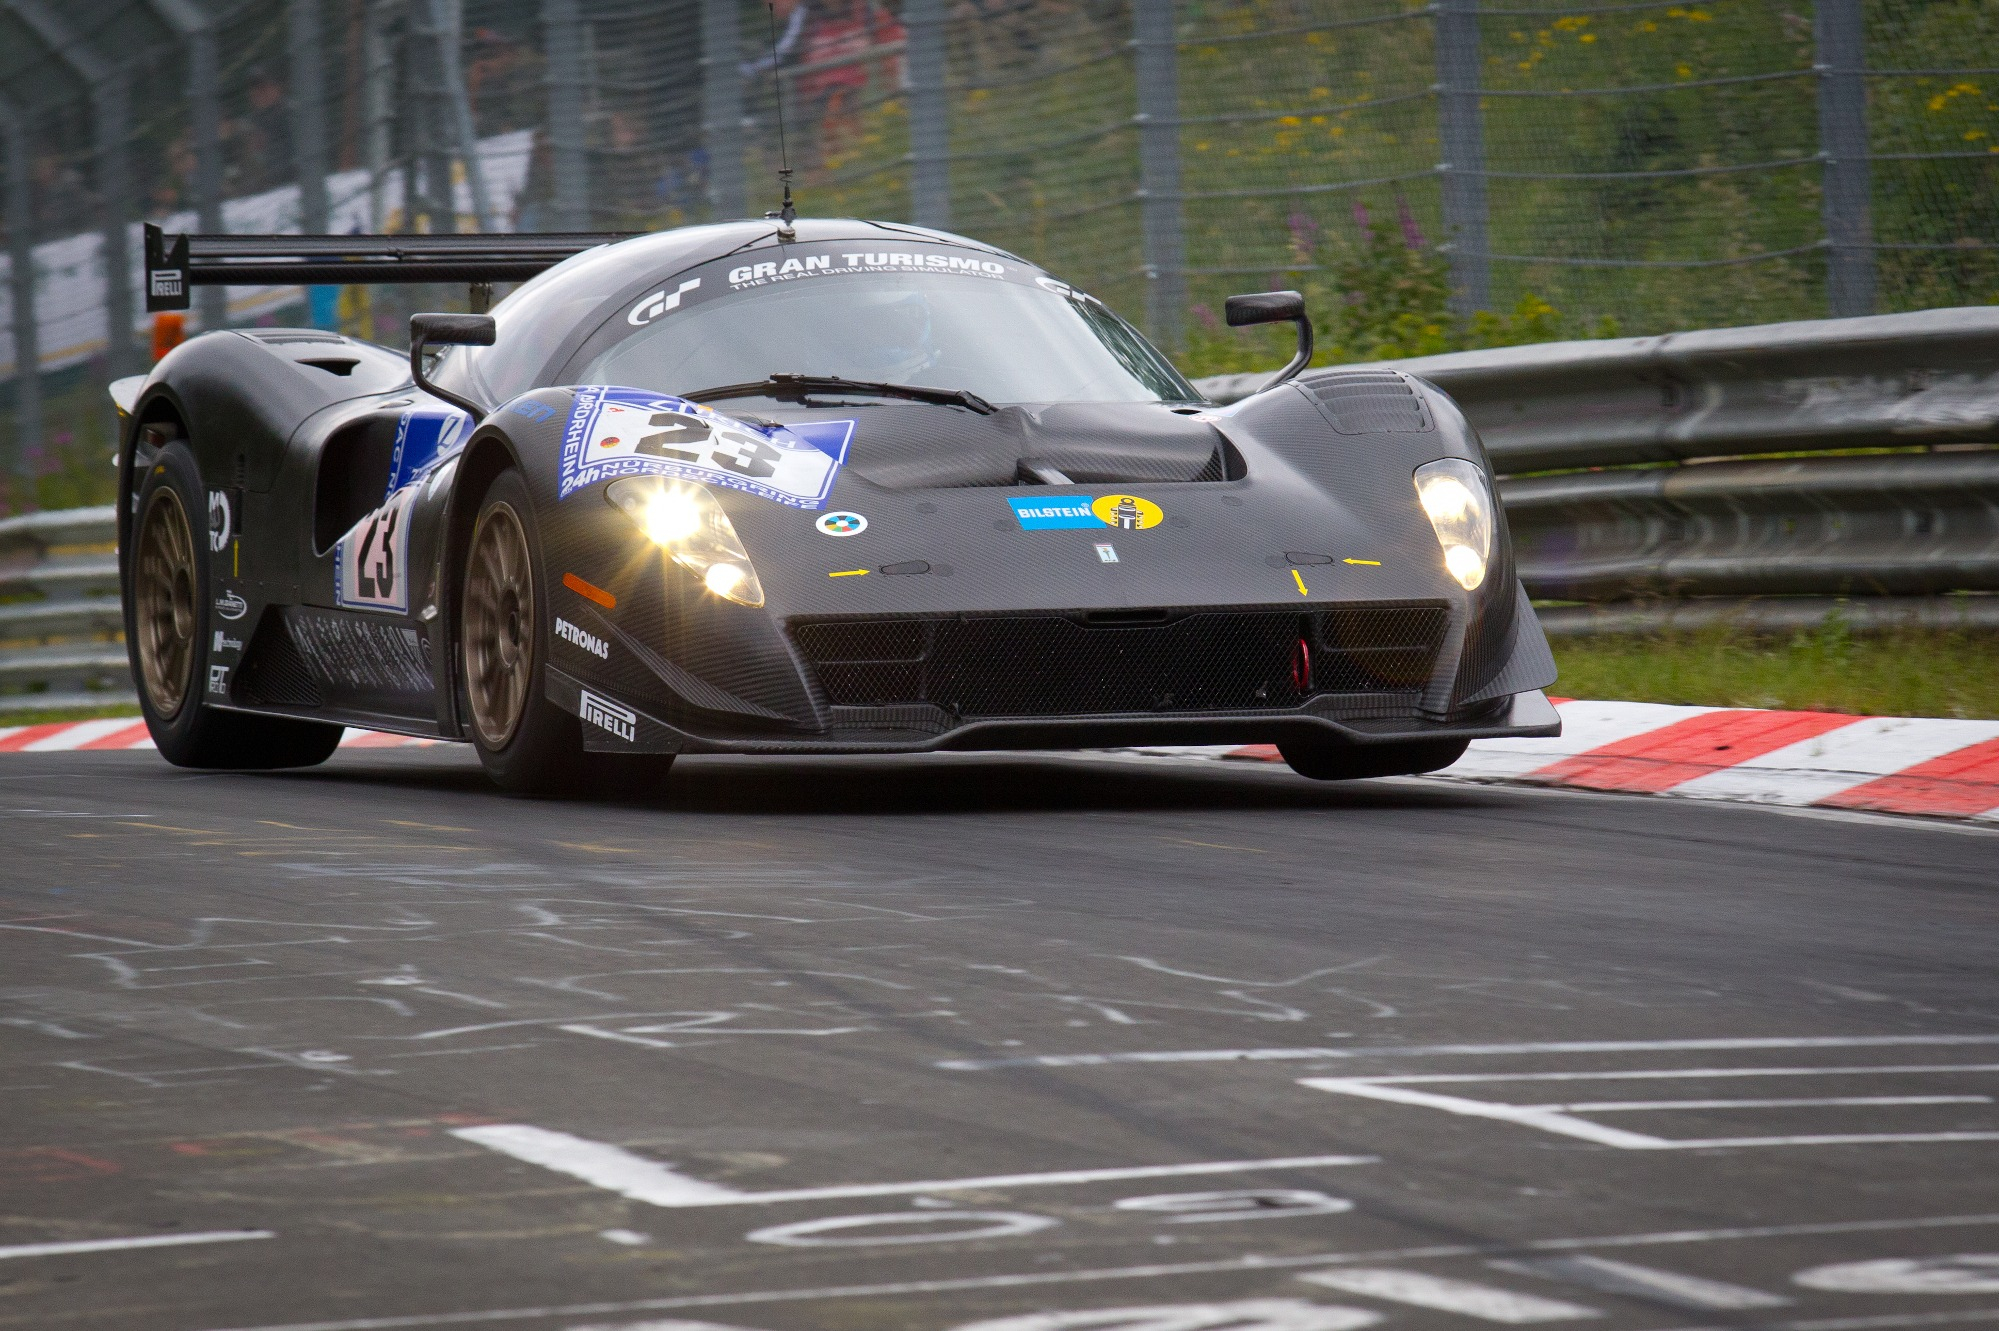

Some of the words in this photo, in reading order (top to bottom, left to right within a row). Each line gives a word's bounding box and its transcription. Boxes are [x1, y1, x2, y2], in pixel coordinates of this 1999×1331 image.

[151, 269, 182, 296] PIRELLI
[729, 255, 830, 284] GRAN
[842, 253, 1005, 274] TURISMO
[730, 279, 768, 290] THE
[769, 270, 819, 282] REAL
[821, 265, 899, 275] DRIVING
[901, 266, 1004, 280] SIMULATOR
[634, 412, 783, 478] 23
[561, 467, 600, 497] 24h
[1017, 506, 1092, 519] BILSTEIN
[357, 507, 400, 599] 23
[555, 617, 609, 660] PETRONAS
[579, 689, 637, 742] PIRELLI
